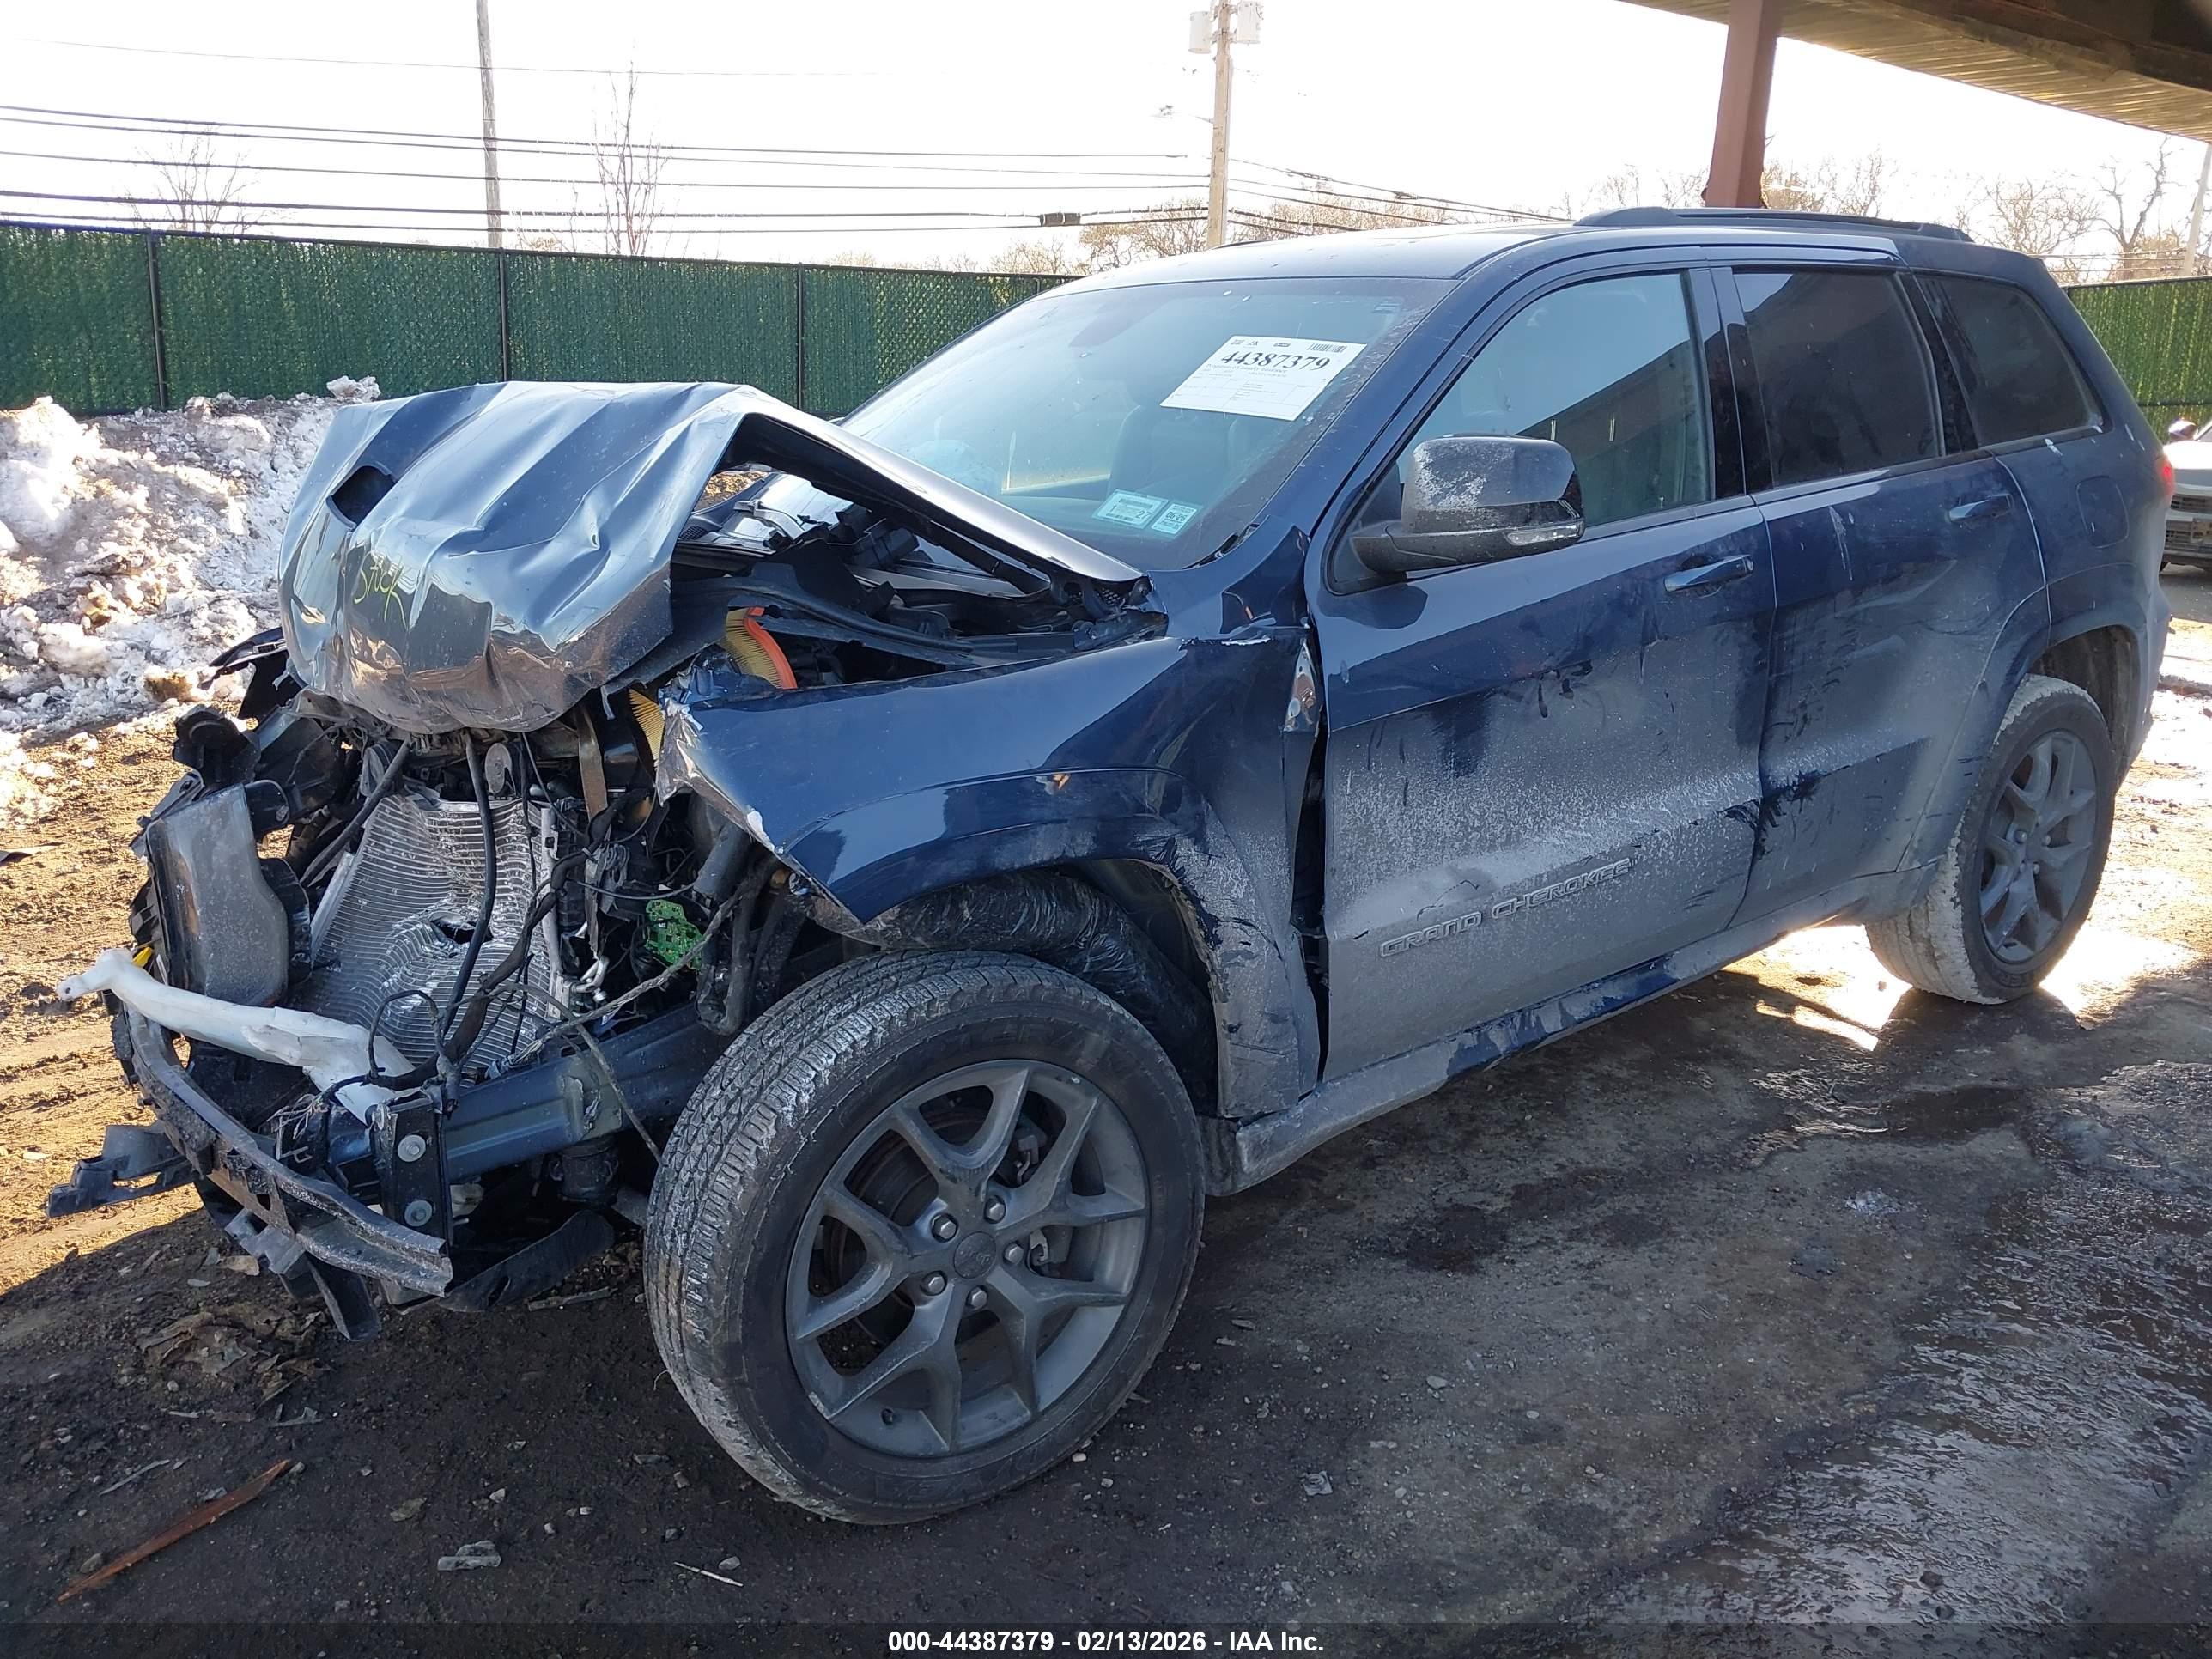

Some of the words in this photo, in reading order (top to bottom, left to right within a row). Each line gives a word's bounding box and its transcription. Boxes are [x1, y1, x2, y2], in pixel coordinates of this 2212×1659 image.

[1221, 350, 1330, 371] 44387379
[1380, 911, 1482, 957] GRAND
[1492, 857, 1631, 920] CHEROKEE
